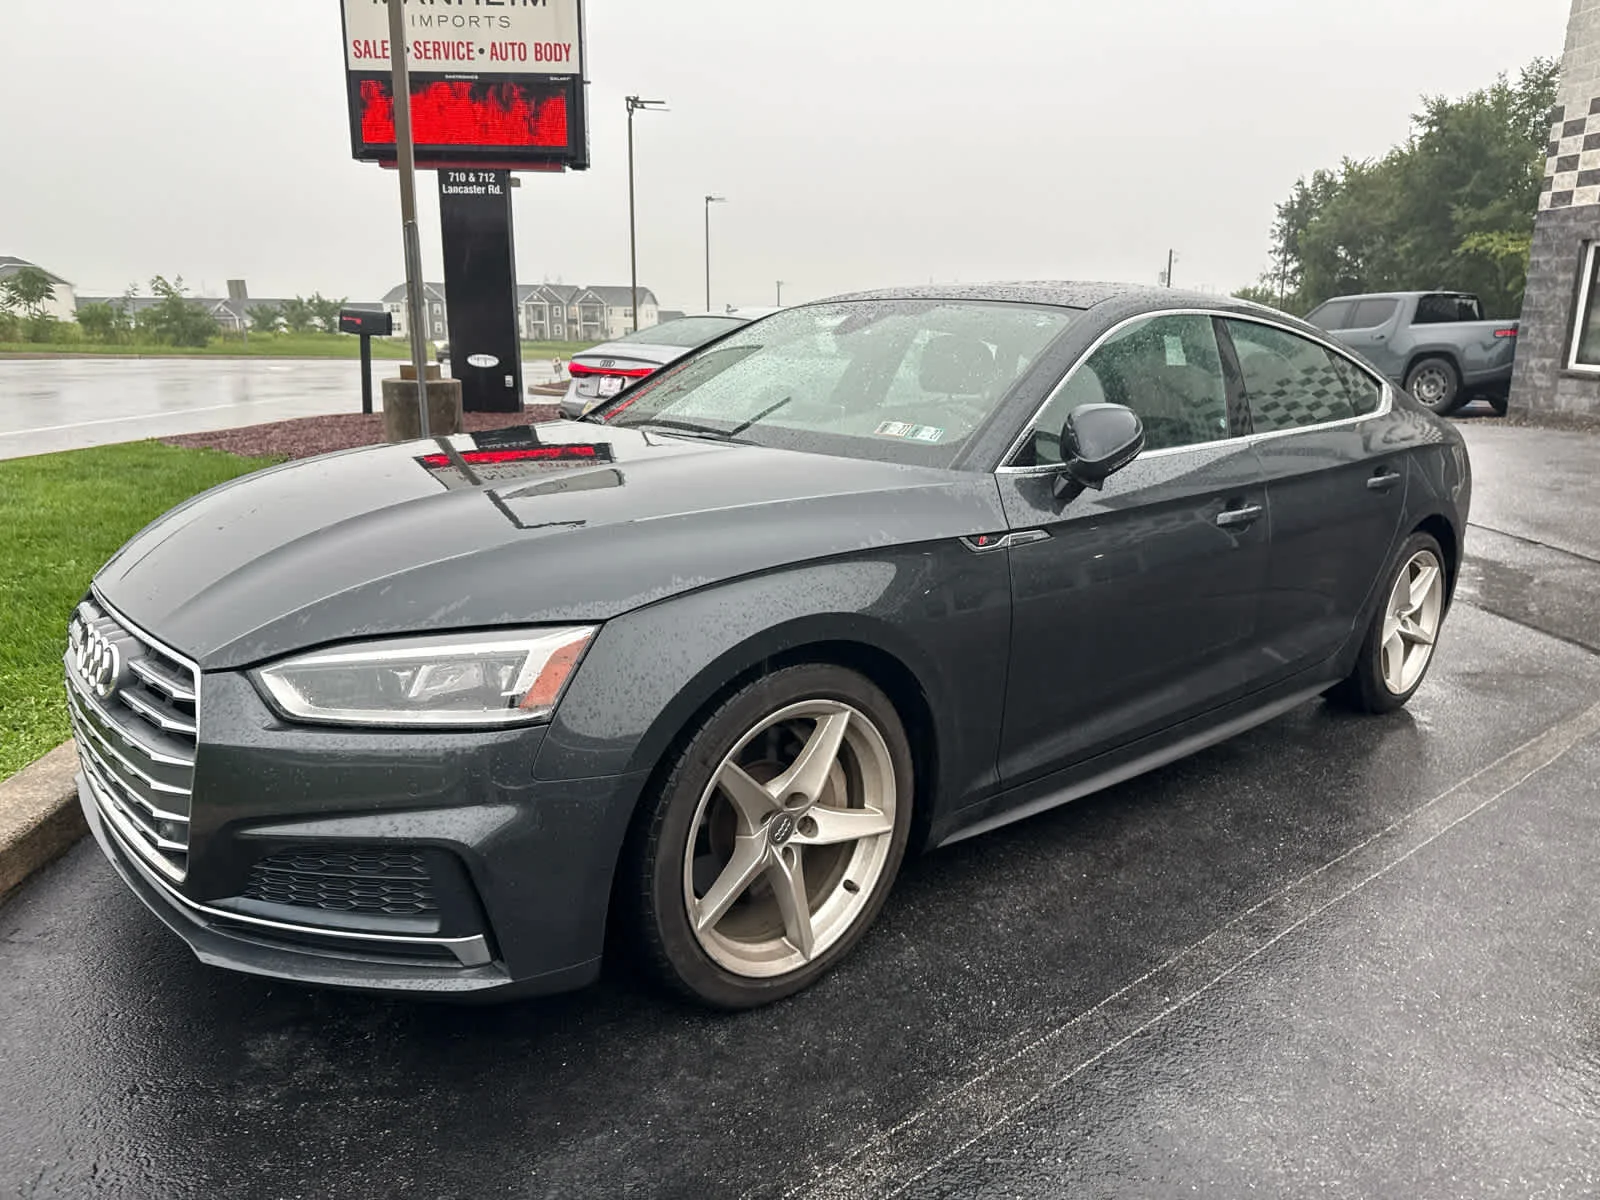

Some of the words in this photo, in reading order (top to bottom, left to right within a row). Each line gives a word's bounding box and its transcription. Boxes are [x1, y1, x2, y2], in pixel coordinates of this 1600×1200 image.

[411, 15, 511, 29] IMPORTS
[352, 39, 390, 60] SALE
[413, 40, 475, 61] SERVICE
[490, 41, 527, 62] AUTO
[534, 42, 572, 62] BODY
[448, 172, 466, 182] 710
[468, 172, 475, 182] &
[478, 172, 495, 182] 712
[442, 184, 485, 194] Lancaster
[488, 184, 503, 194] Rd.
